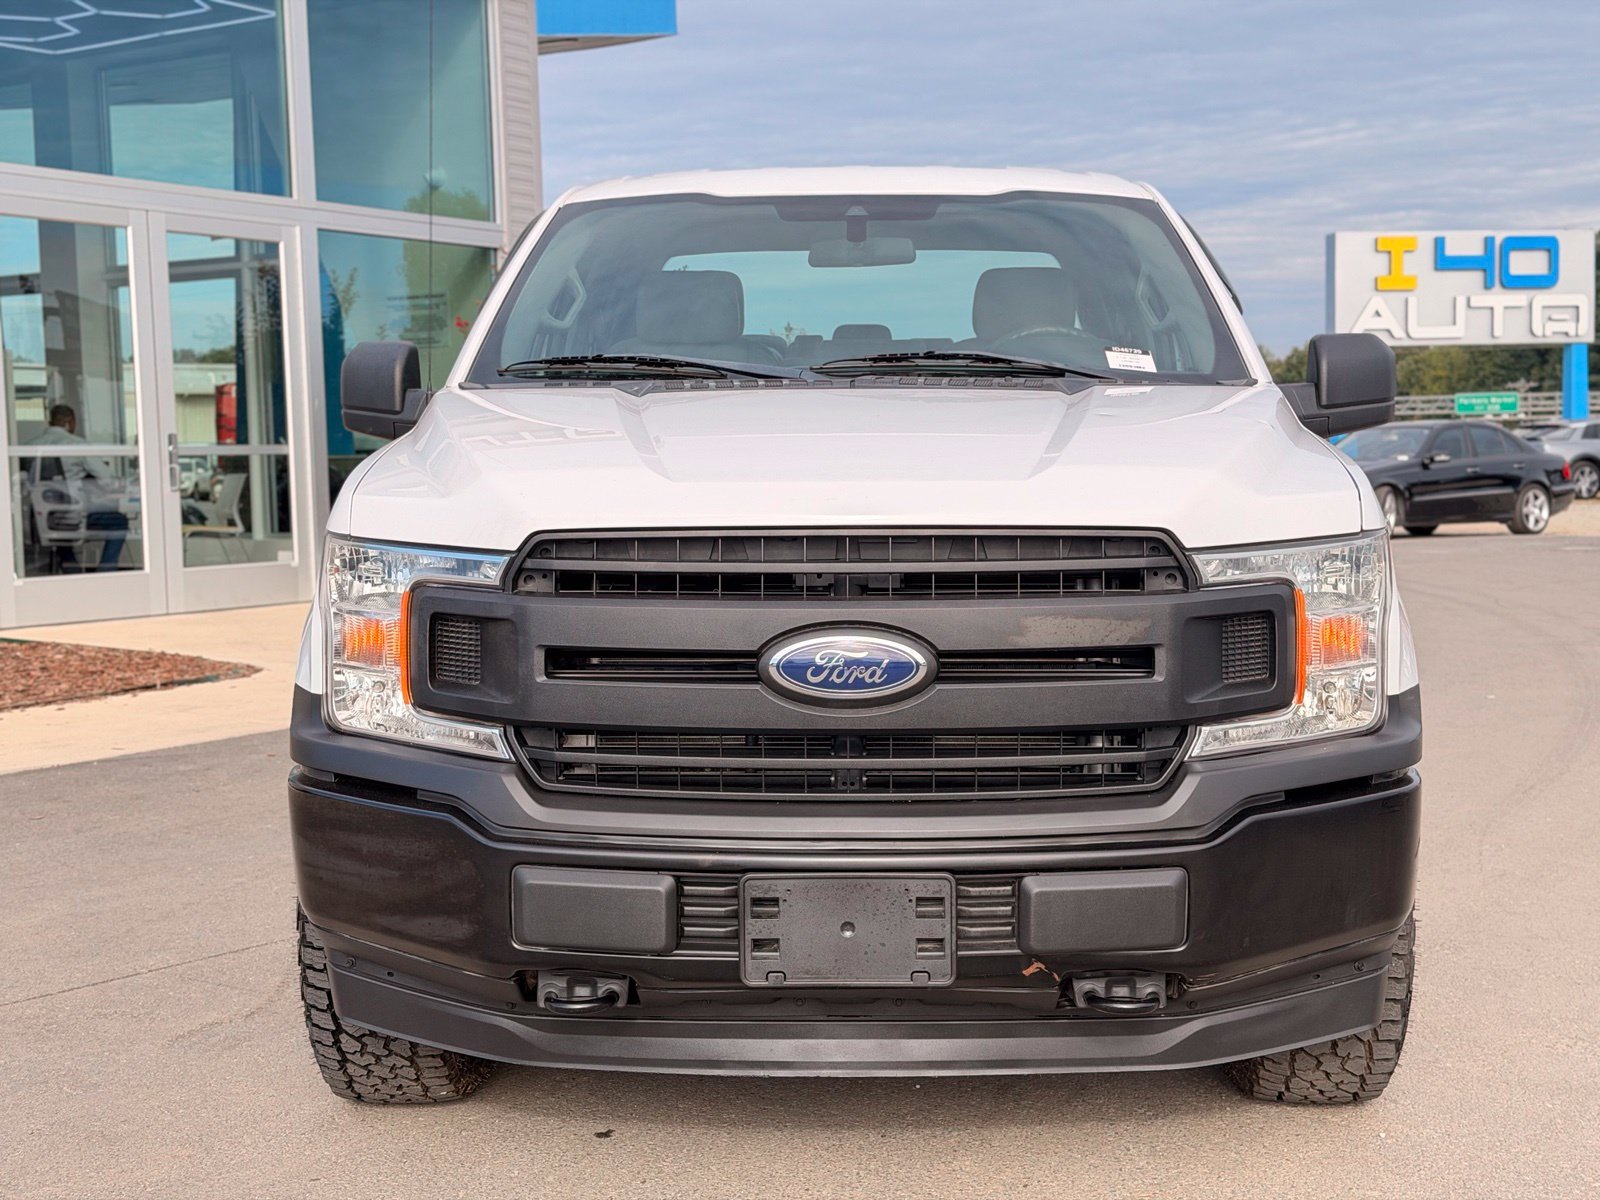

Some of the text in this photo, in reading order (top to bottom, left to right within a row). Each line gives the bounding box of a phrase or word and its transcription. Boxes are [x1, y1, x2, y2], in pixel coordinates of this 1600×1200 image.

[1375, 235, 1560, 291] I 40
[806, 650, 890, 684] Ford
